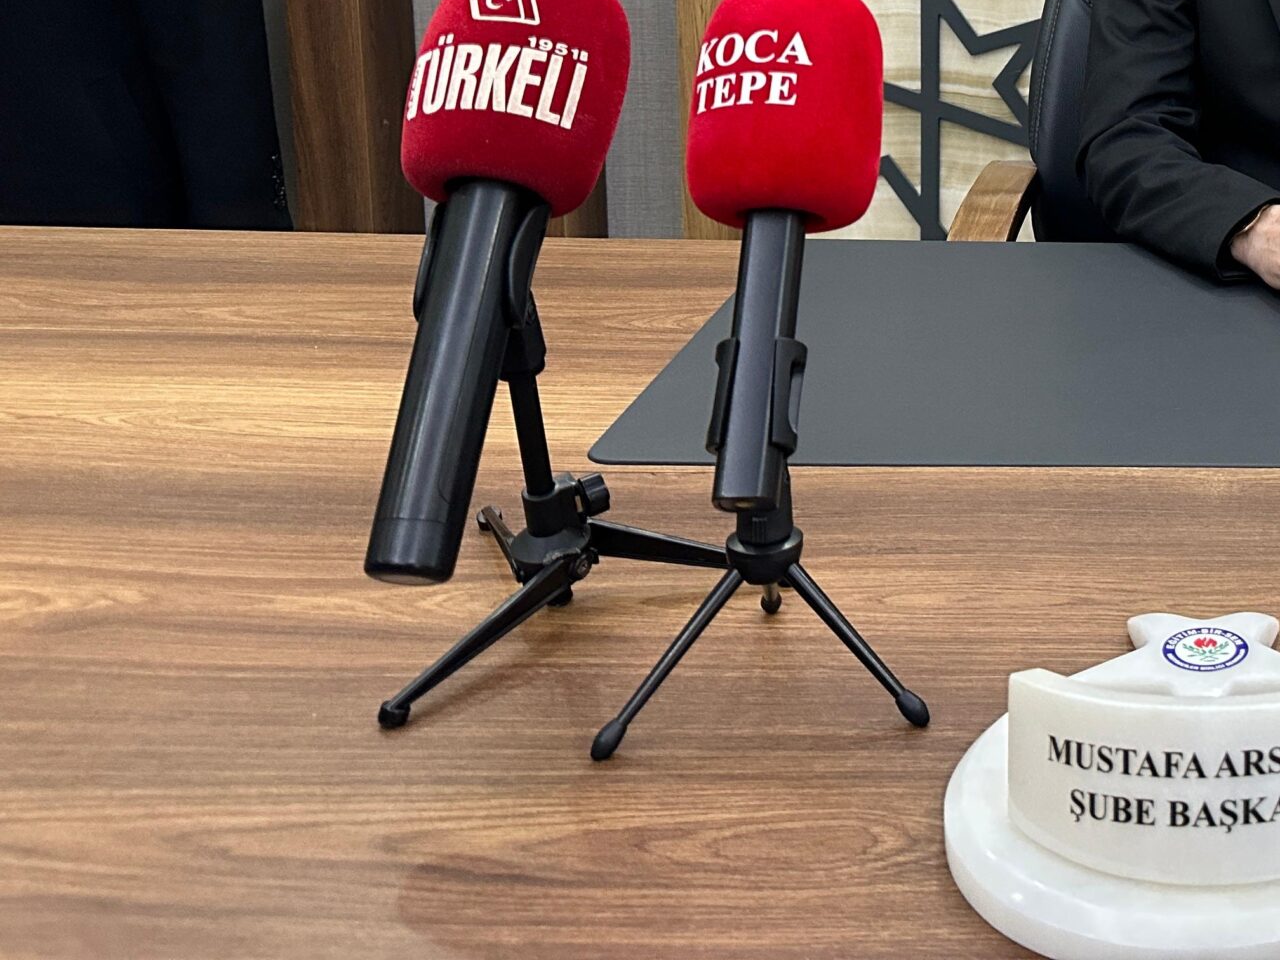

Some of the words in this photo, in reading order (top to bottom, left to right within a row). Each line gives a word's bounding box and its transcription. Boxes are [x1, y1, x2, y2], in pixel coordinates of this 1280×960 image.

[696, 29, 813, 77] KOCA
[406, 33, 588, 130] TÜRKELİ
[696, 70, 798, 115] TEPE
[1047, 734, 1206, 779] MUSTAFA
[1069, 788, 1156, 826] ŞUBE
